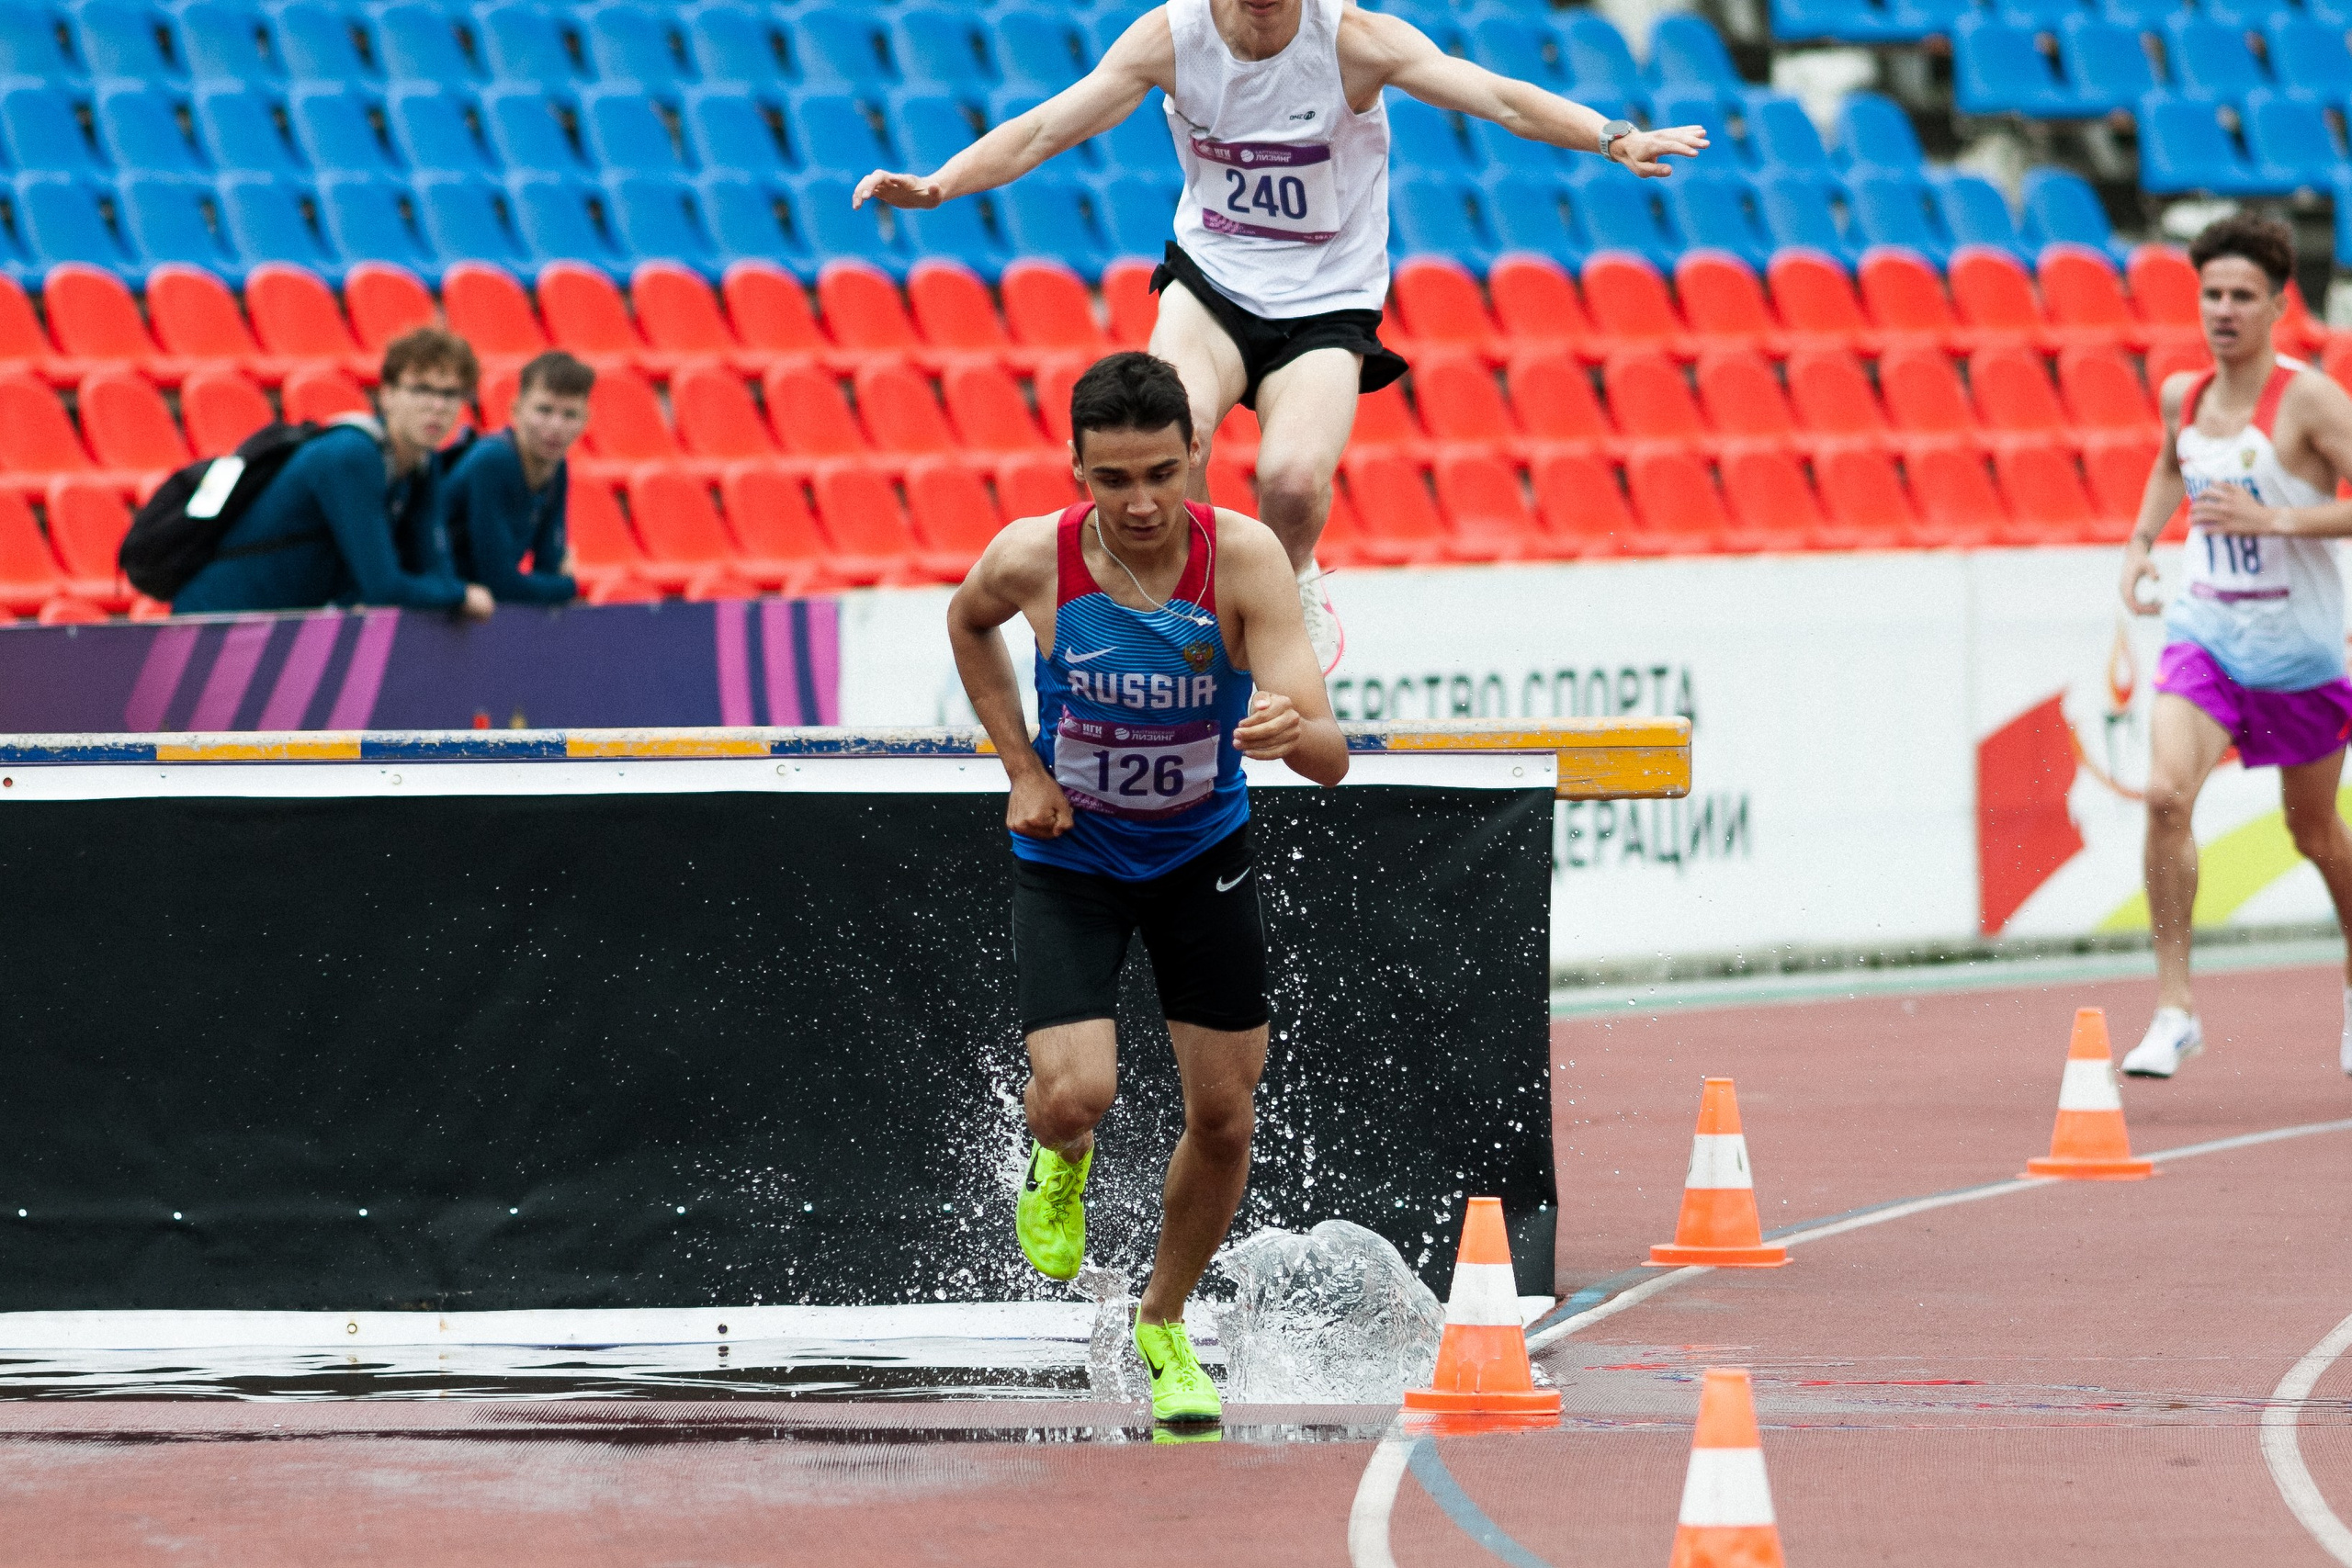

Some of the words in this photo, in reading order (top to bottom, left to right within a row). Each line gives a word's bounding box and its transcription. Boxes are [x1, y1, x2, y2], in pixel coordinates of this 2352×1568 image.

[1226, 168, 1307, 220] 240
[2203, 534, 2262, 575] 118
[1068, 670, 1217, 709] RUSSIA
[1333, 673, 1507, 719] ЕРСТВО
[1131, 733, 1175, 741] ЛИЗИНГ
[1092, 750, 1184, 797] 126
[1553, 793, 1749, 871] ЕРАЦИИ
